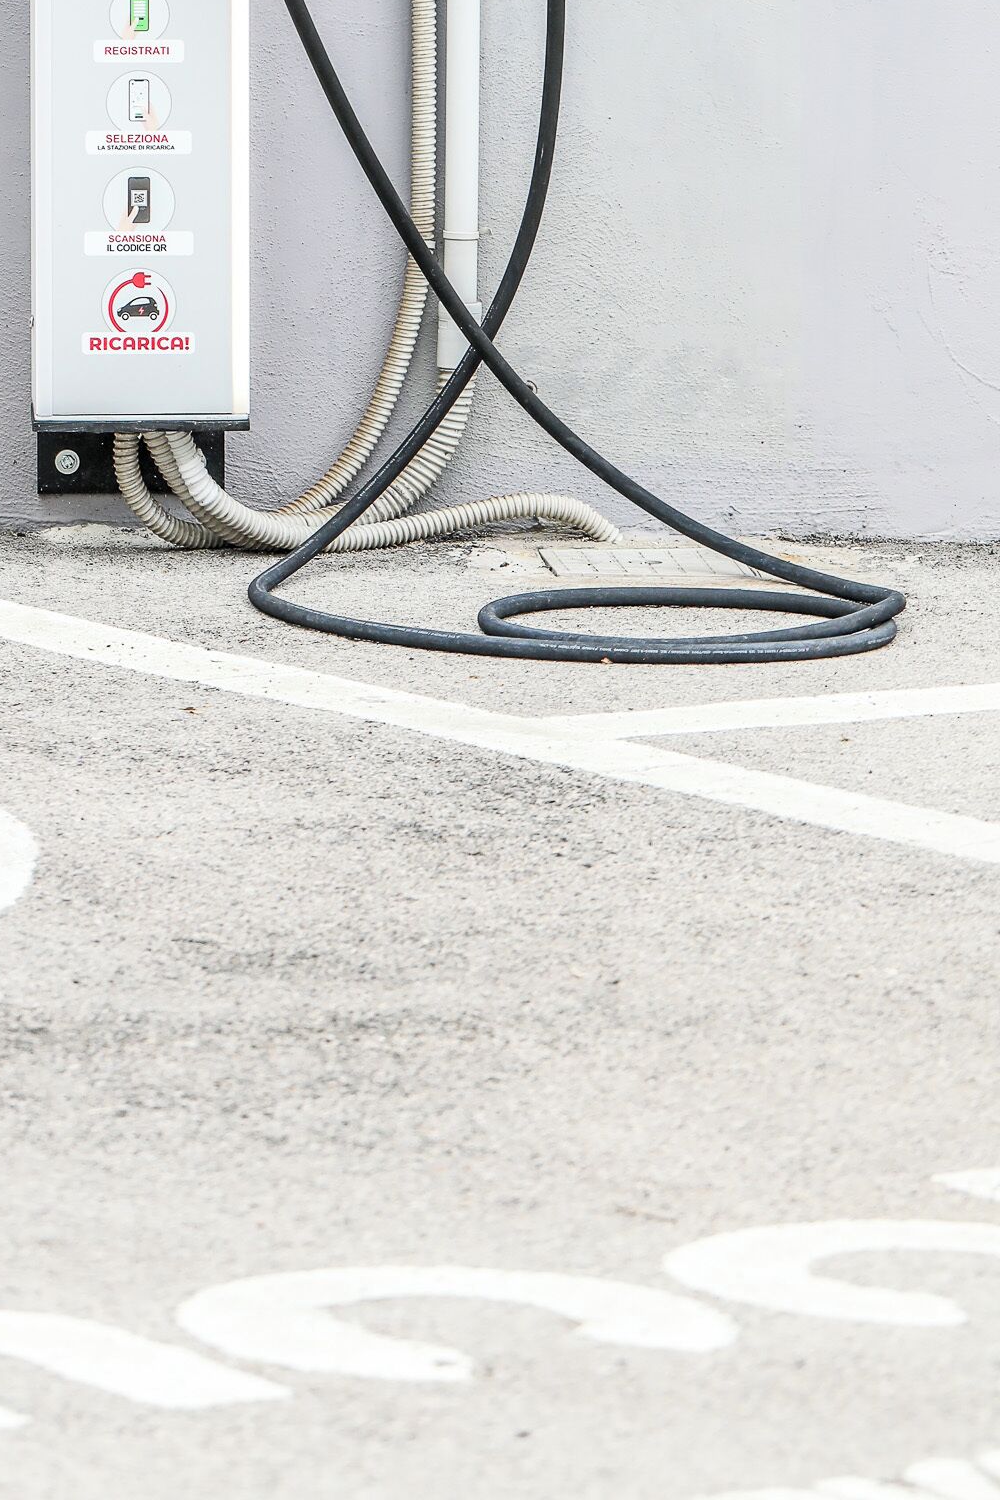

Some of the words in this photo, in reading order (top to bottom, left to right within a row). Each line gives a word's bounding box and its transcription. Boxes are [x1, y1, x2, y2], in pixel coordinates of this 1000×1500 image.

[104, 46, 170, 55] REGISTRATI
[105, 134, 169, 143] SELEZIONA
[108, 234, 166, 243] SCANSIONA
[106, 244, 115, 252] IL
[116, 244, 151, 252] CODICE
[154, 244, 167, 252] QR
[89, 337, 190, 351] RICARICA!
